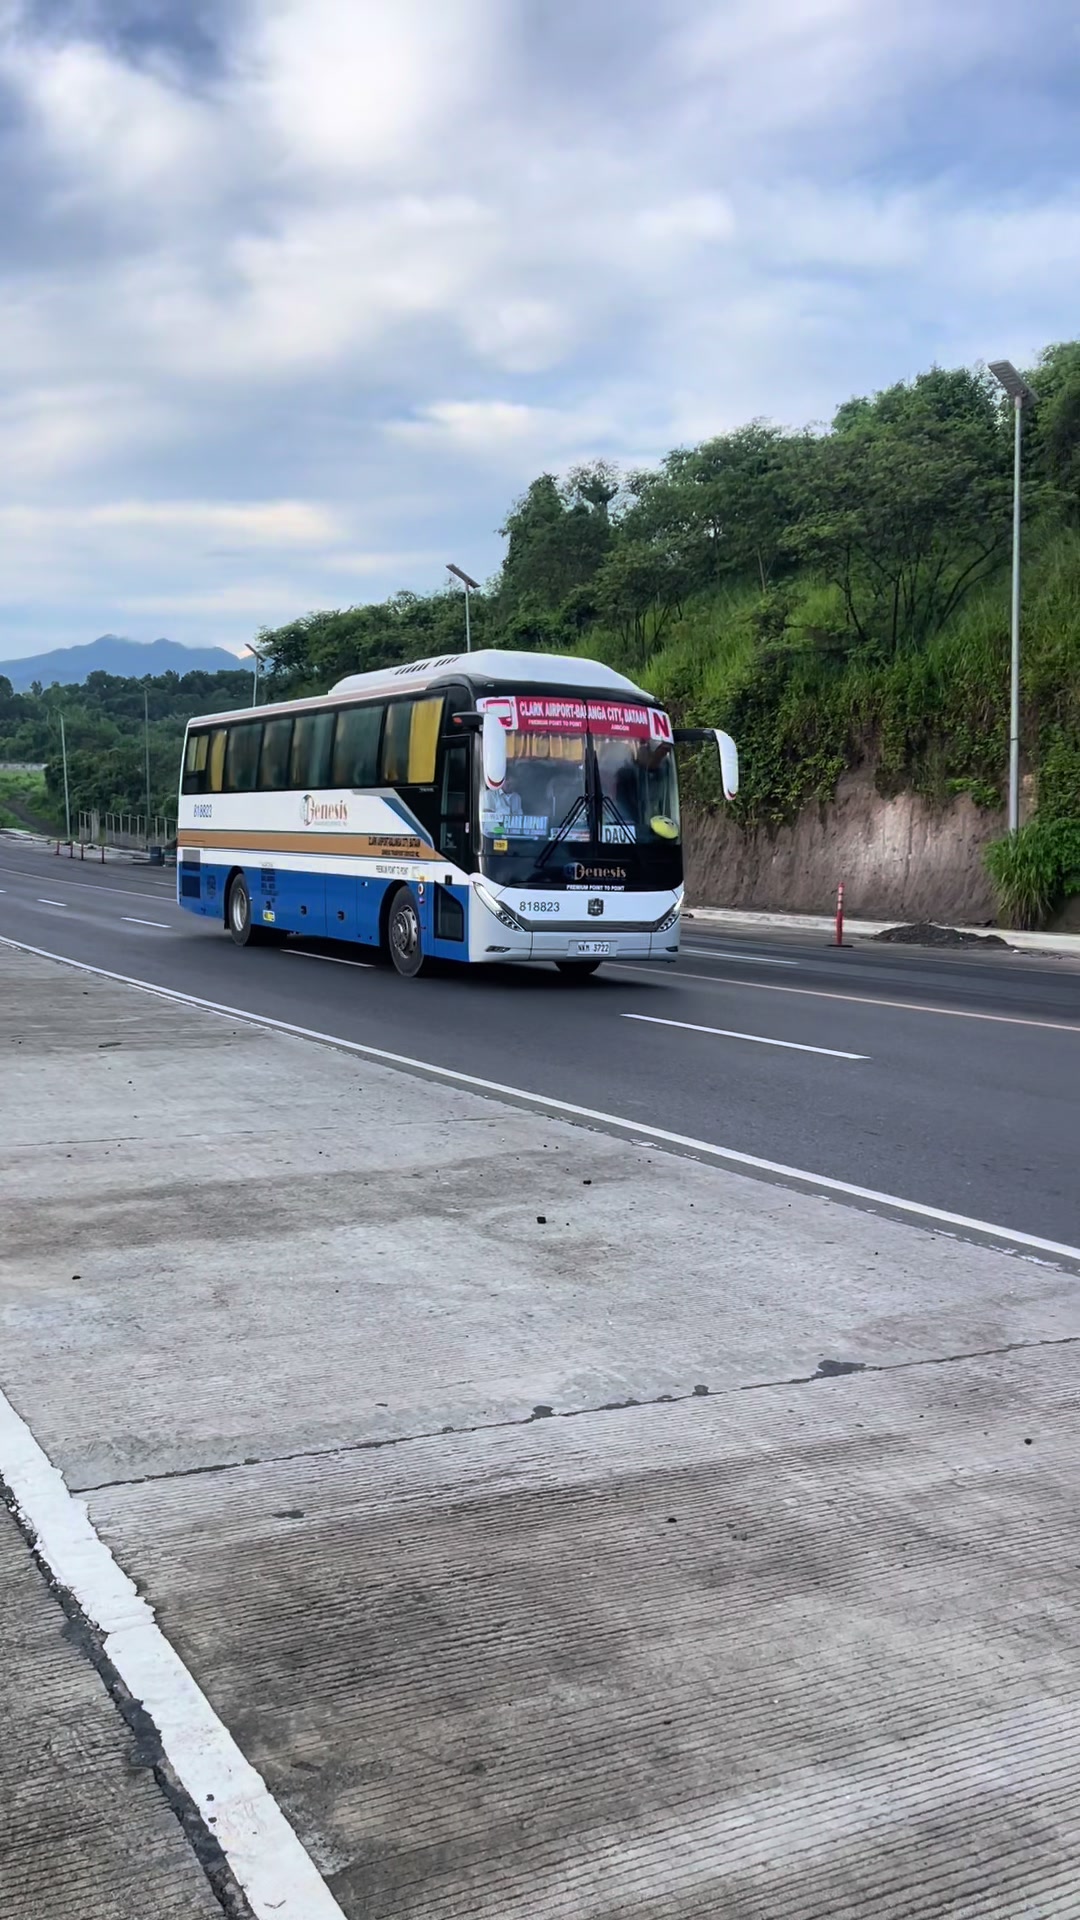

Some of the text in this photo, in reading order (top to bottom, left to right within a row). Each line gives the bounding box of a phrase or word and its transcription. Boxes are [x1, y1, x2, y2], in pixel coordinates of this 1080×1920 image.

[519, 701, 543, 717] CLARK
[624, 708, 648, 725] BATAAN
[653, 712, 670, 738] N
[303, 794, 347, 826] Genesis
[573, 862, 627, 881] Genesis
[519, 901, 560, 913] 818823
[593, 944, 609, 953] 3722
